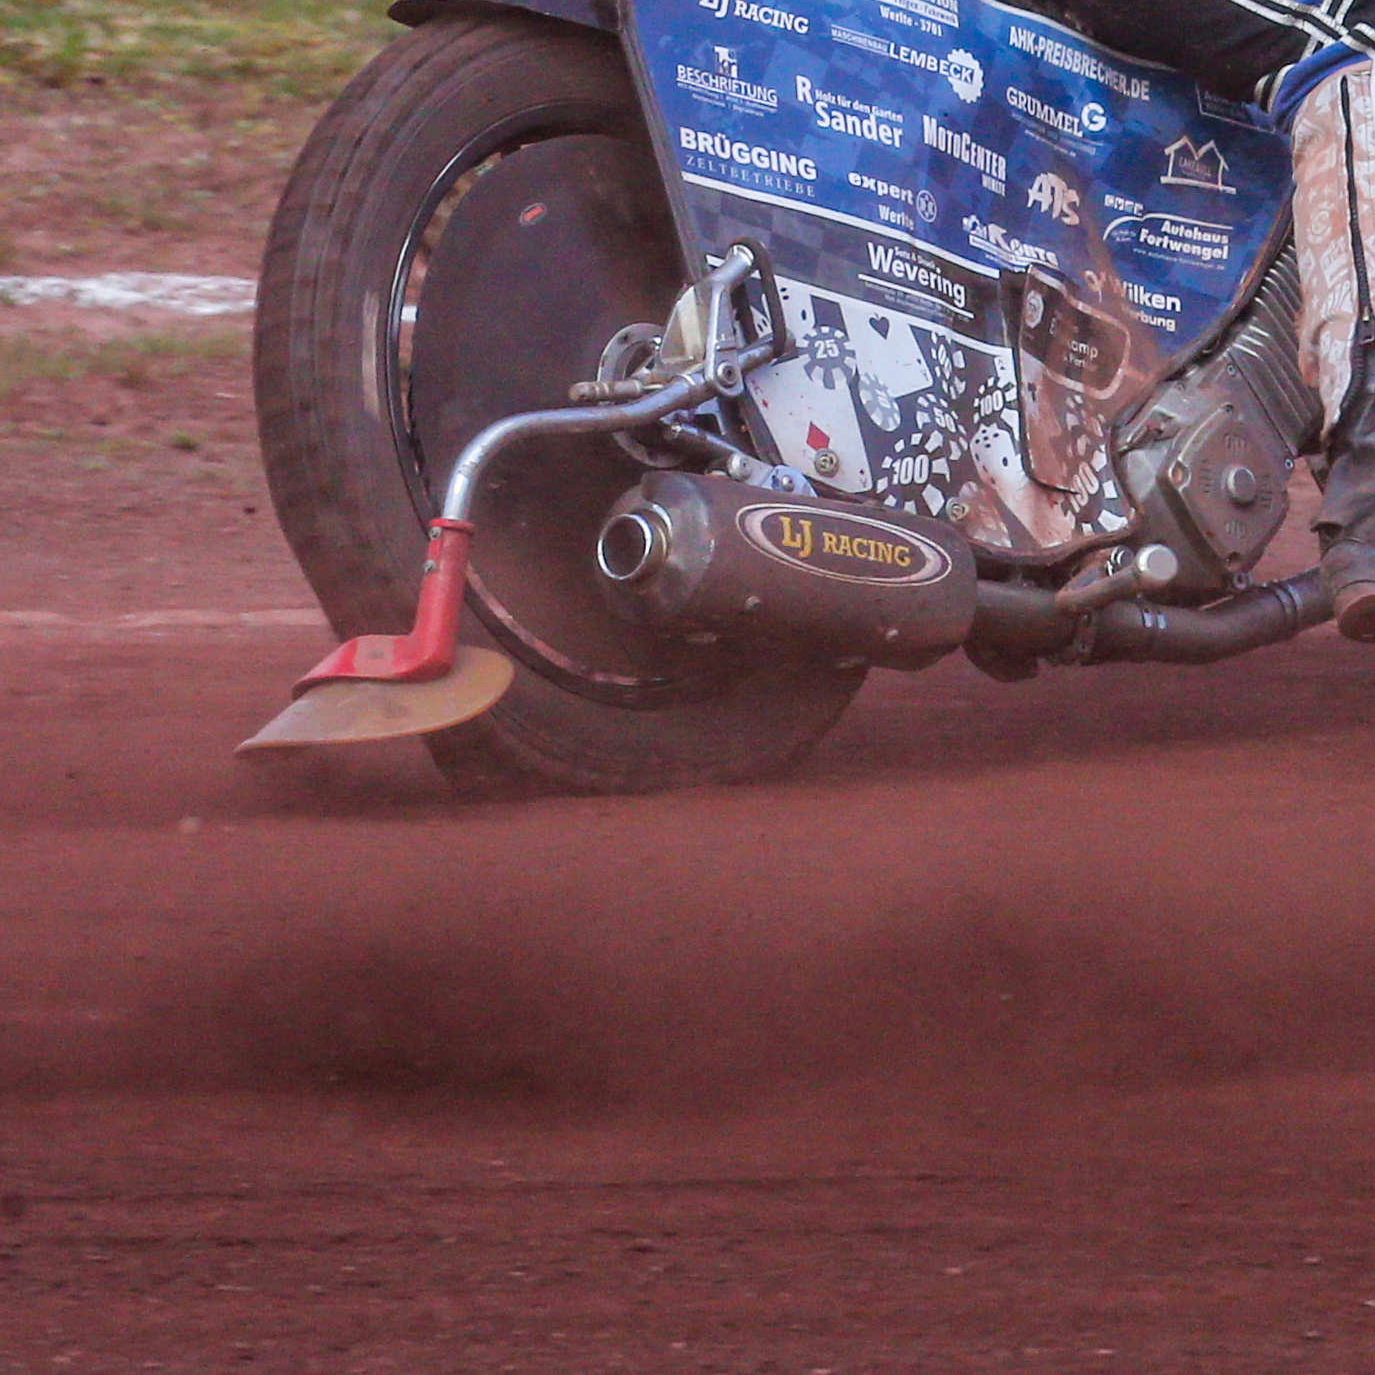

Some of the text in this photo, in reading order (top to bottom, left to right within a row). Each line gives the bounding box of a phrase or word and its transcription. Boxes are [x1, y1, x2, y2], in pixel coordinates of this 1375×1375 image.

[733, 0, 809, 35] RACING
[889, 42, 975, 84] LEMBECK
[1008, 26, 1150, 100] AHK-PREISBRECHER.DE
[676, 64, 778, 104] BESCHRIFTUNG
[814, 101, 904, 148] Sander
[815, 89, 903, 123] Holz für den Garten
[1006, 86, 1083, 138] GRUMMEL
[679, 126, 818, 181] BRÜGGING
[686, 154, 816, 198] ZELTBETRIEBE
[848, 172, 913, 205] expert
[1139, 228, 1229, 261] Fortwengel
[1160, 220, 1229, 245] Autohaus
[867, 242, 967, 308] Wevering
[814, 339, 840, 359] 25
[980, 389, 1004, 417] 100
[892, 454, 929, 486] 100
[779, 516, 912, 569] LJ RACING
